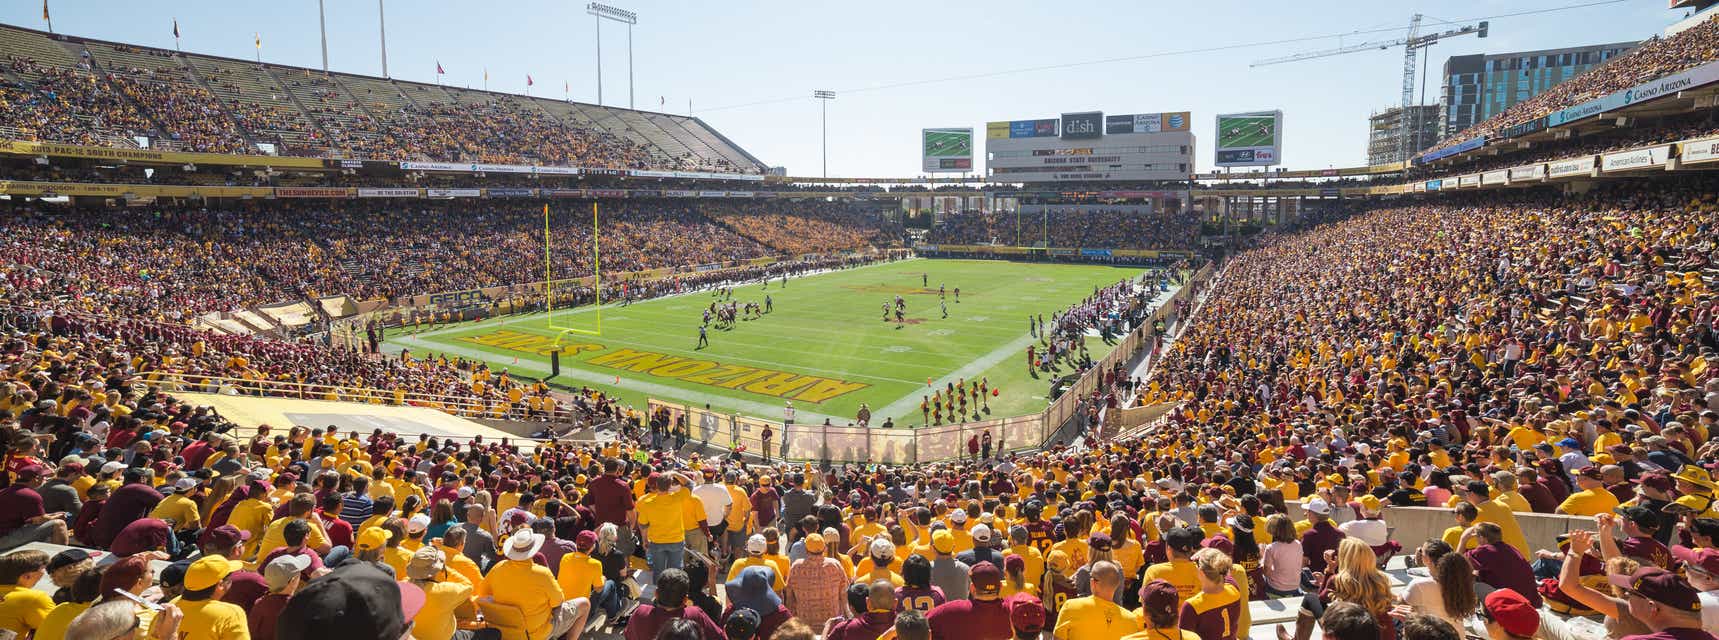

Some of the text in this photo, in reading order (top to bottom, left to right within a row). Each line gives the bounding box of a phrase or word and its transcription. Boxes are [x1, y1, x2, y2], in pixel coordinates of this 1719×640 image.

[1067, 119, 1094, 134] dish
[117, 151, 162, 160] CHAMPIONS
[584, 347, 874, 405] ARIZONA
